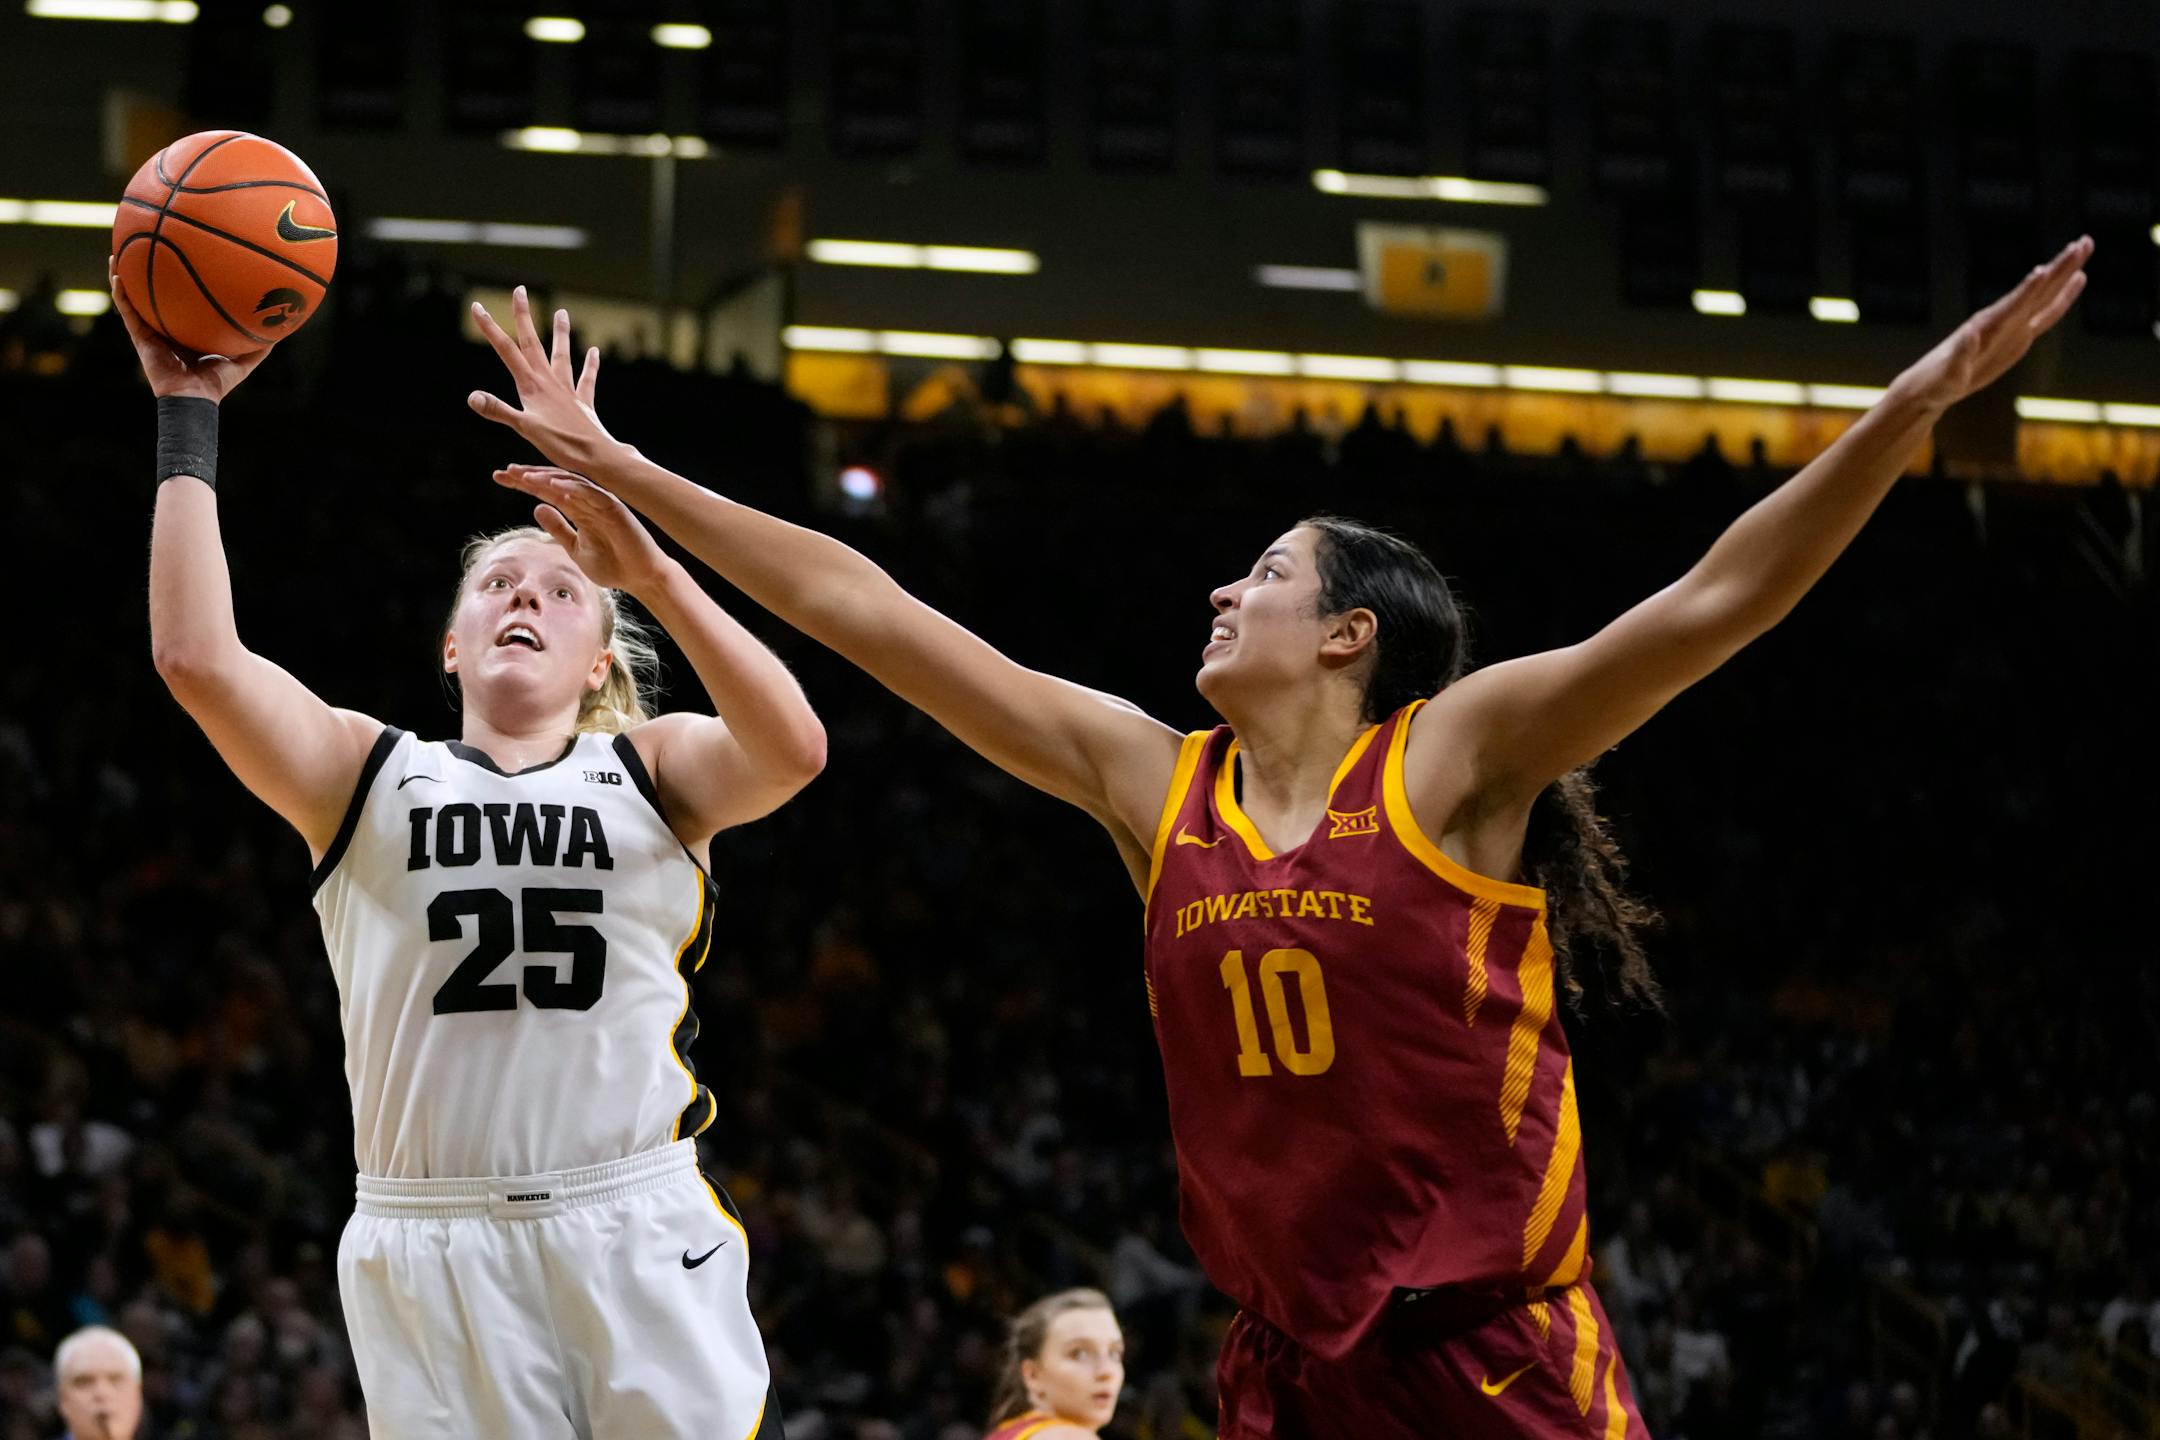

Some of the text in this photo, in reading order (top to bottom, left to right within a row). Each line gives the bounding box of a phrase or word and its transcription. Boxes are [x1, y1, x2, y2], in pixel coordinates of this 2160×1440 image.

[407, 803, 614, 871] IOWA
[427, 887, 608, 1016] 25
[1219, 948, 1336, 1077] 10
[506, 1192, 551, 1203] HAWKEYES
